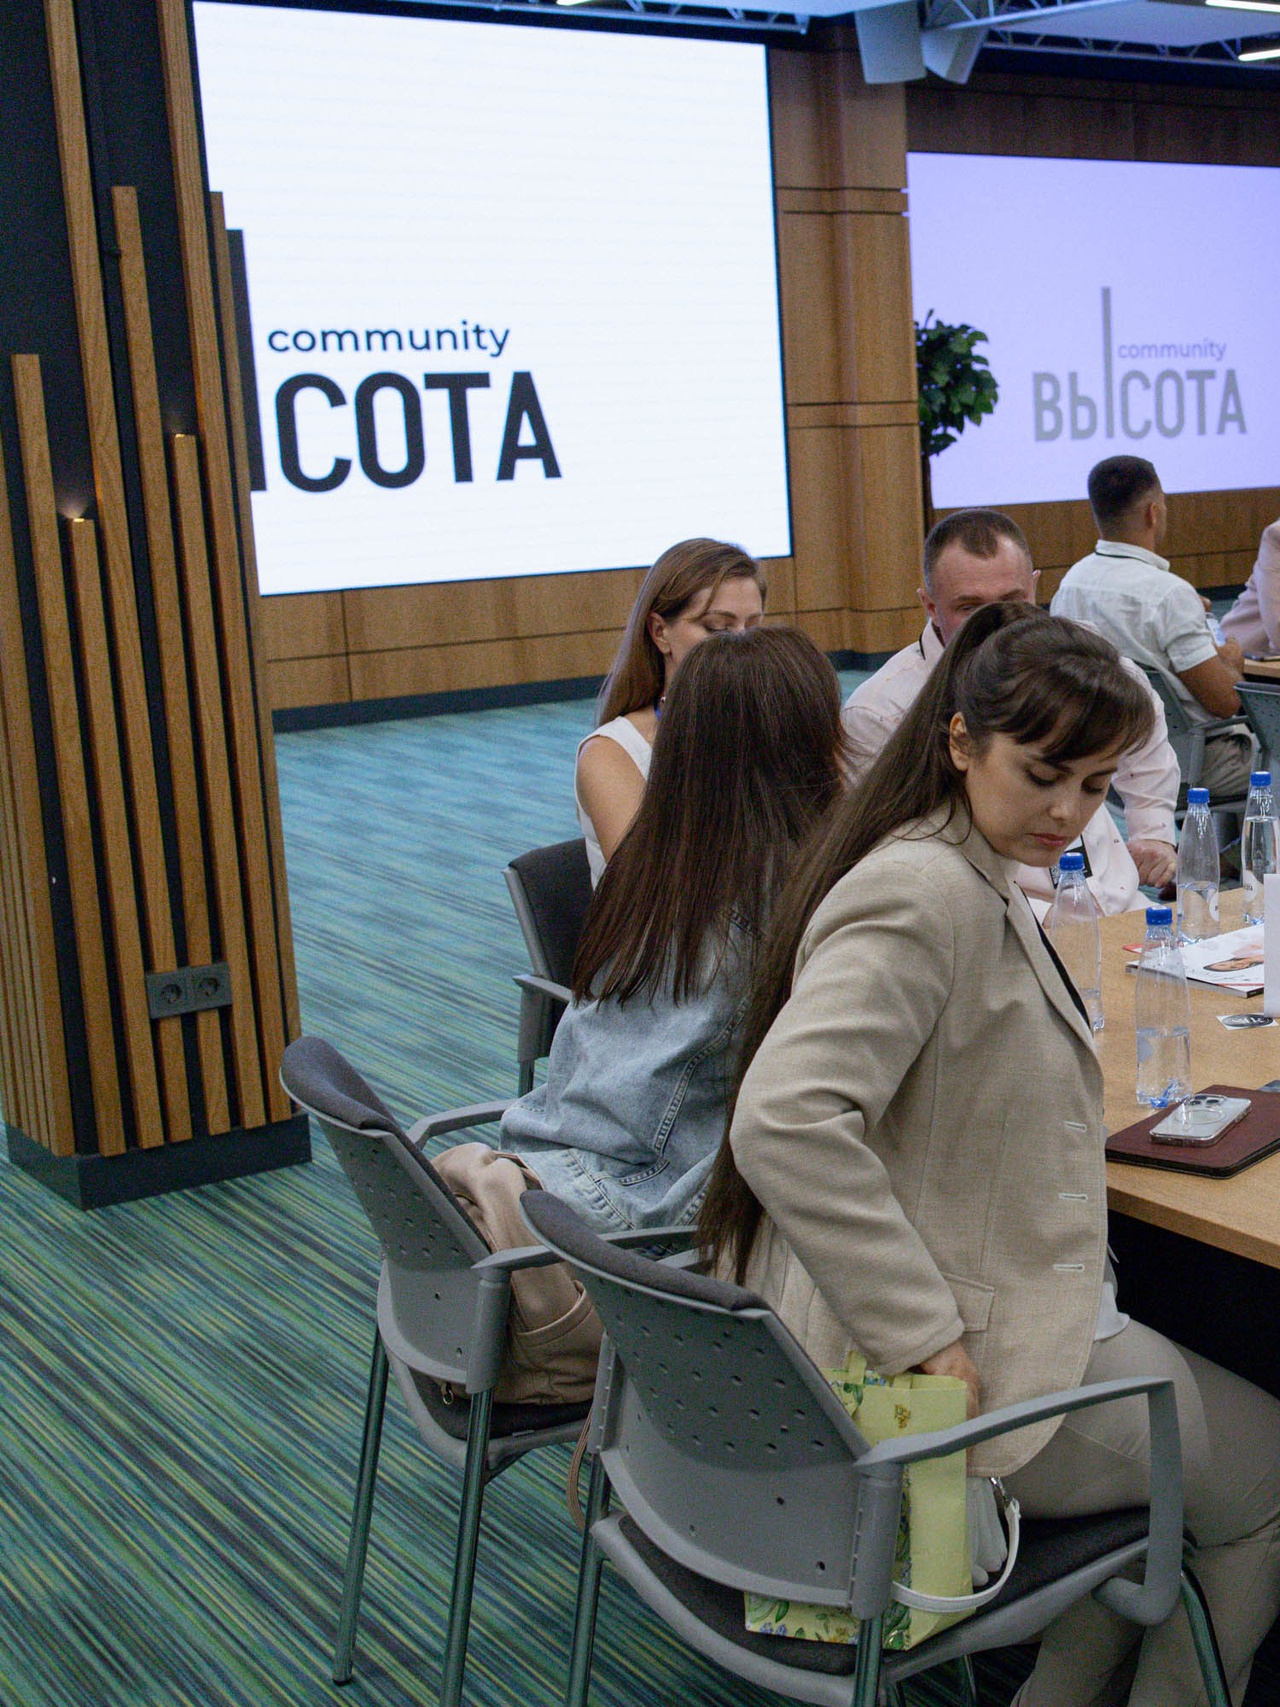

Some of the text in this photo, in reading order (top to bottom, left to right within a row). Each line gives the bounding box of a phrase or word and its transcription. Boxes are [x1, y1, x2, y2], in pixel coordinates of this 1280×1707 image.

[267, 319, 510, 358] community
[1117, 338, 1227, 362] community
[1033, 286, 1247, 442] ВЫСОТА
